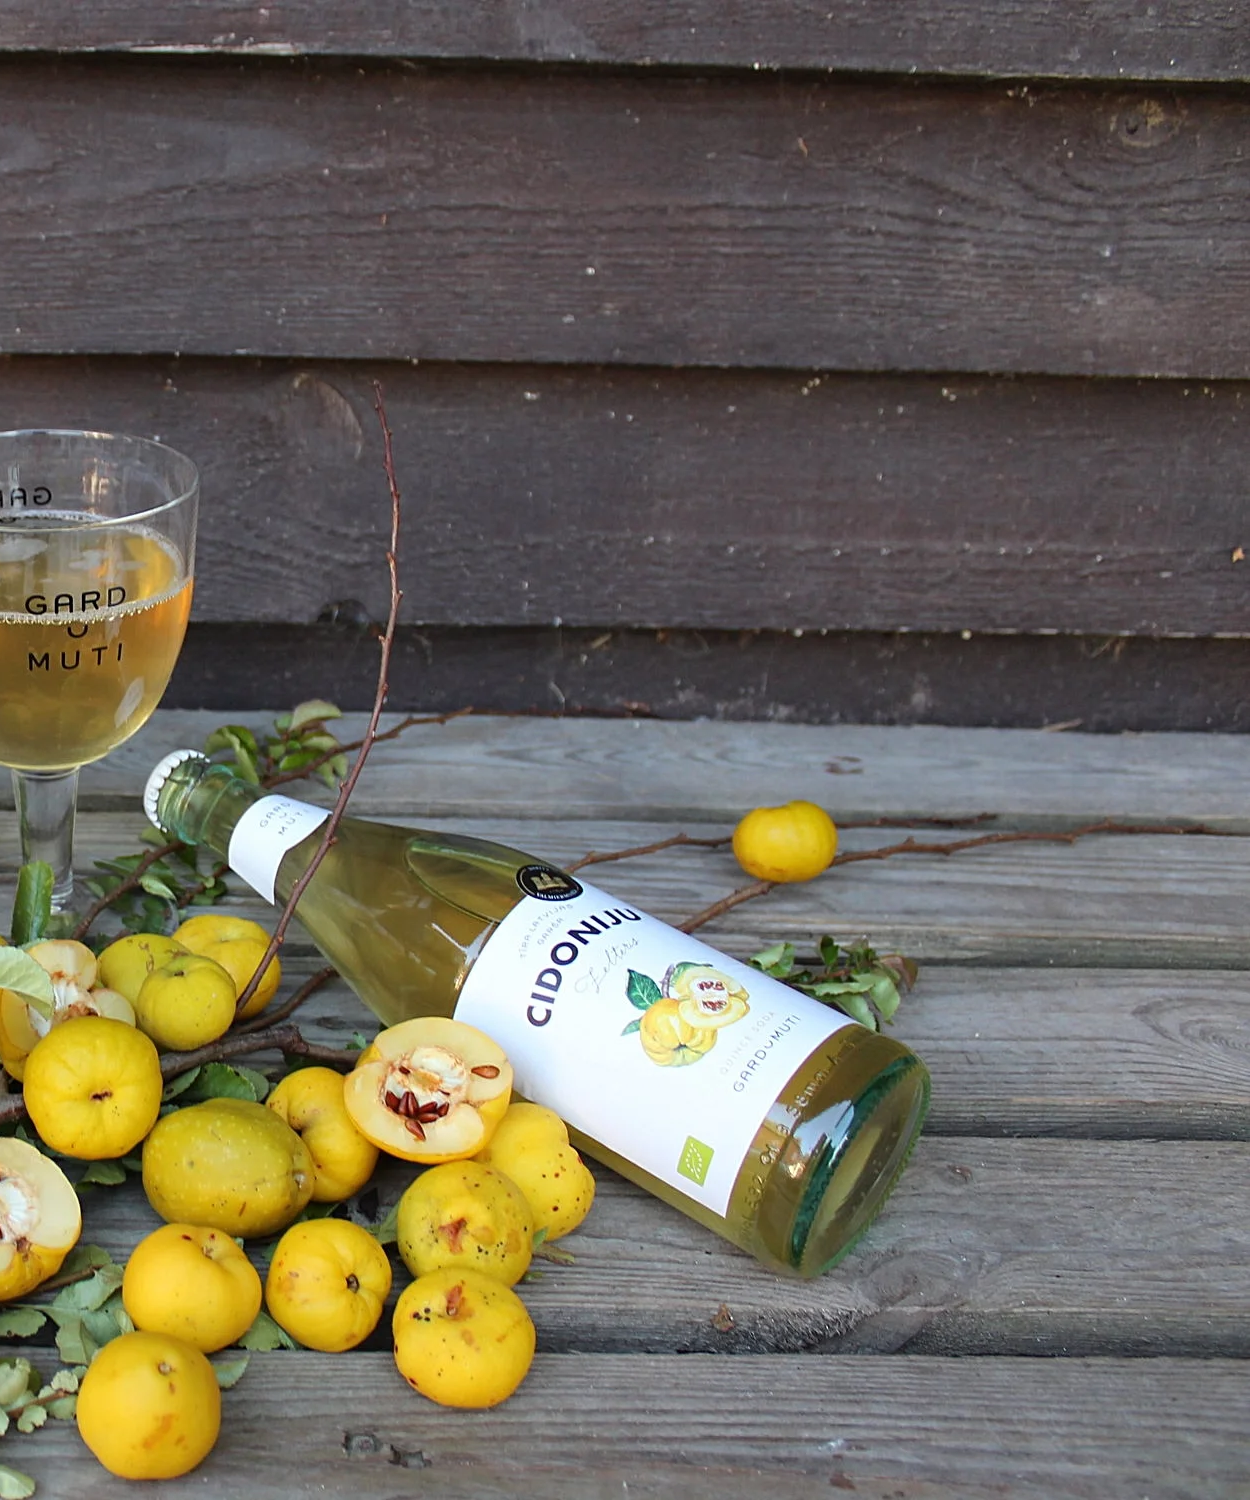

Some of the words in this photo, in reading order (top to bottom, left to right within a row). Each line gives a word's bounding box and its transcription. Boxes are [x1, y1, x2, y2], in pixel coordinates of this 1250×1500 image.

[25, 586, 126, 615] GARD
[28, 642, 123, 671] MUTI
[526, 907, 642, 1028] CIDONIJU
